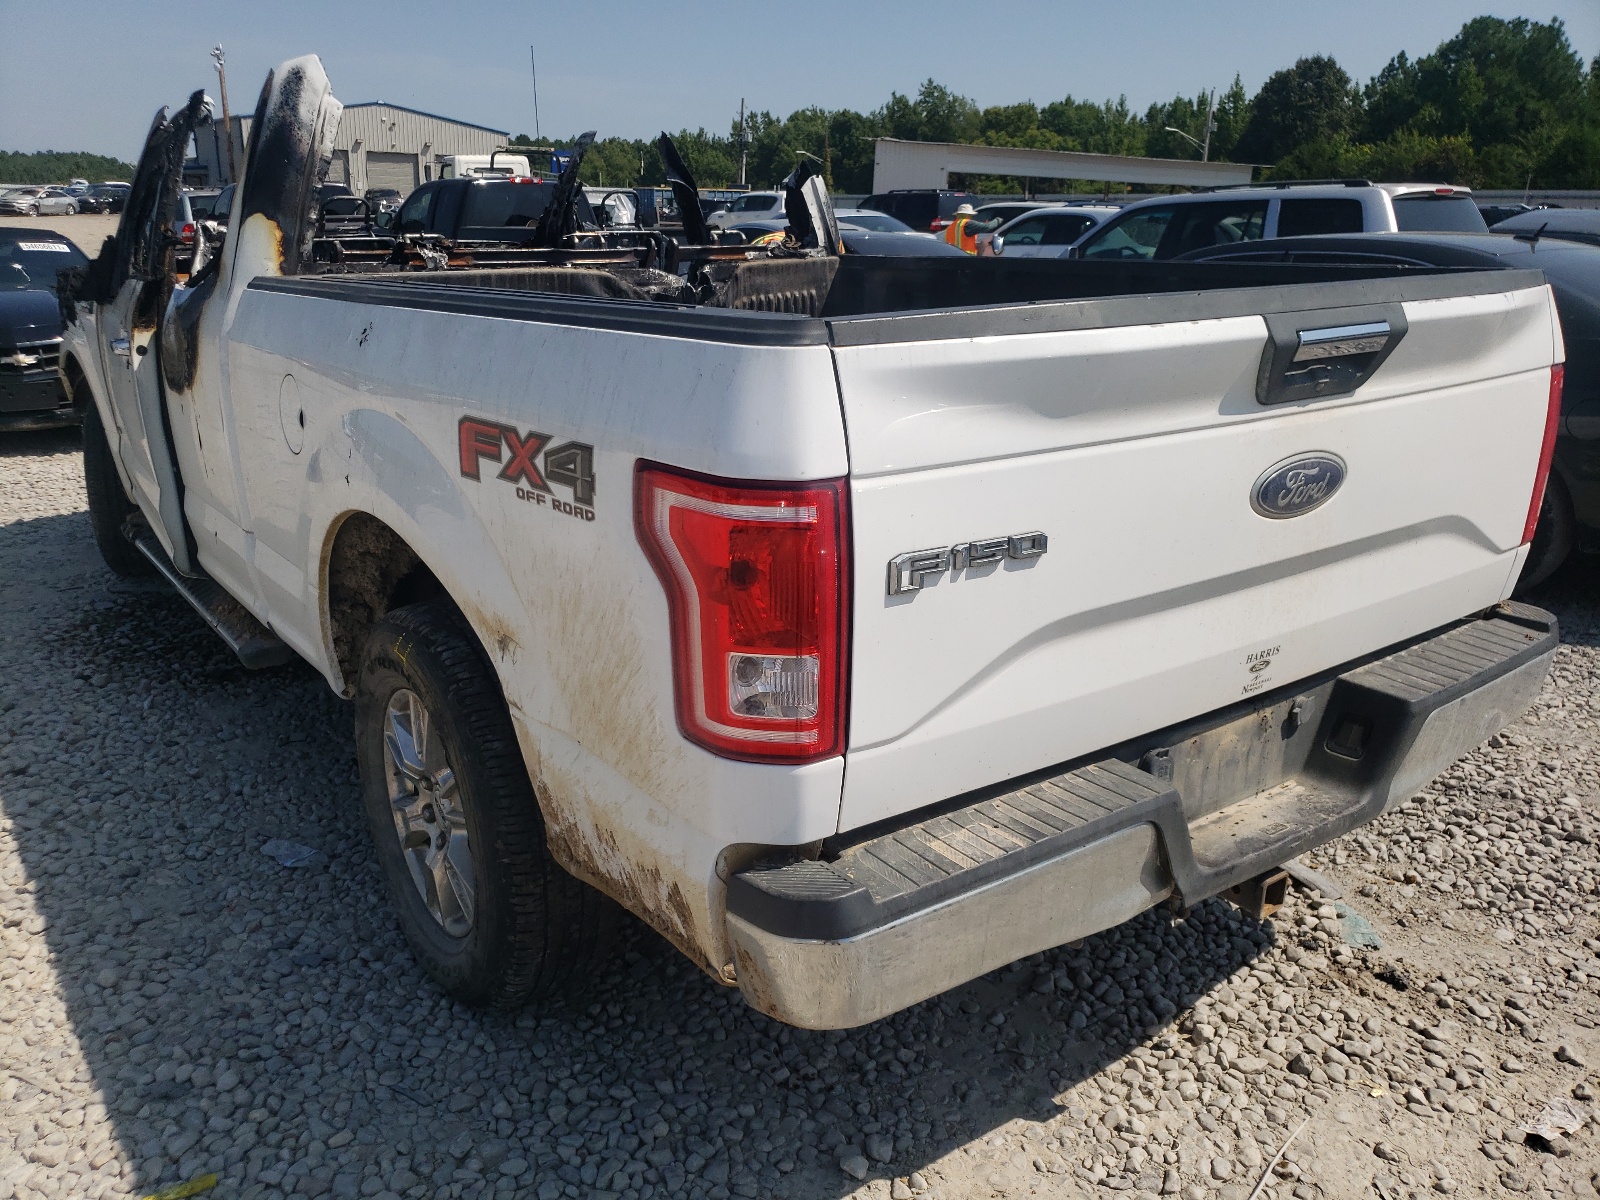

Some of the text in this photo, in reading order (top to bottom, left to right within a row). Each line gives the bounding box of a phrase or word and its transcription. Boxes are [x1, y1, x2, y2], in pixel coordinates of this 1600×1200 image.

[458, 414, 596, 509] FX4
[516, 486, 596, 522] OFF ROAD
[1277, 466, 1331, 507] Ford
[1245, 645, 1281, 664] HARRIS
